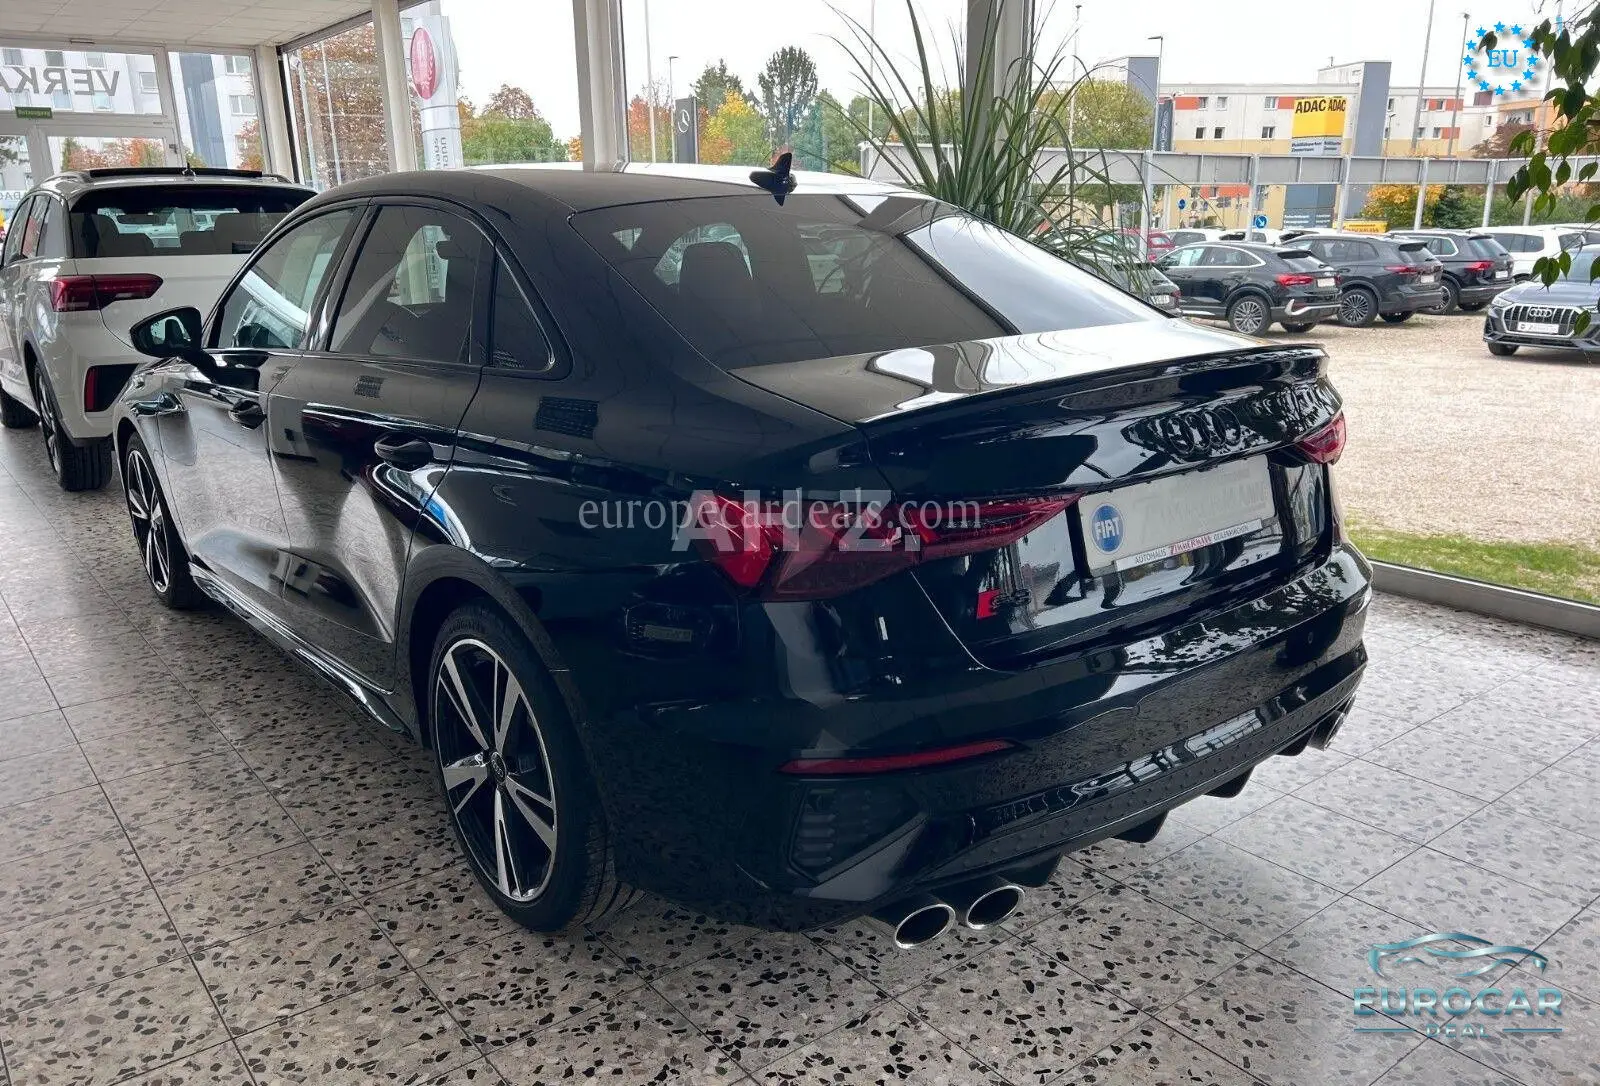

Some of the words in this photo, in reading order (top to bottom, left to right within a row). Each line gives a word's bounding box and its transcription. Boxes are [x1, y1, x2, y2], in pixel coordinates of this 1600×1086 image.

[1295, 99, 1326, 114] ADAC
[1327, 99, 1346, 112] ADAC
[1094, 516, 1120, 541] FIAT
[1136, 548, 1167, 565] AUTOHAUS
